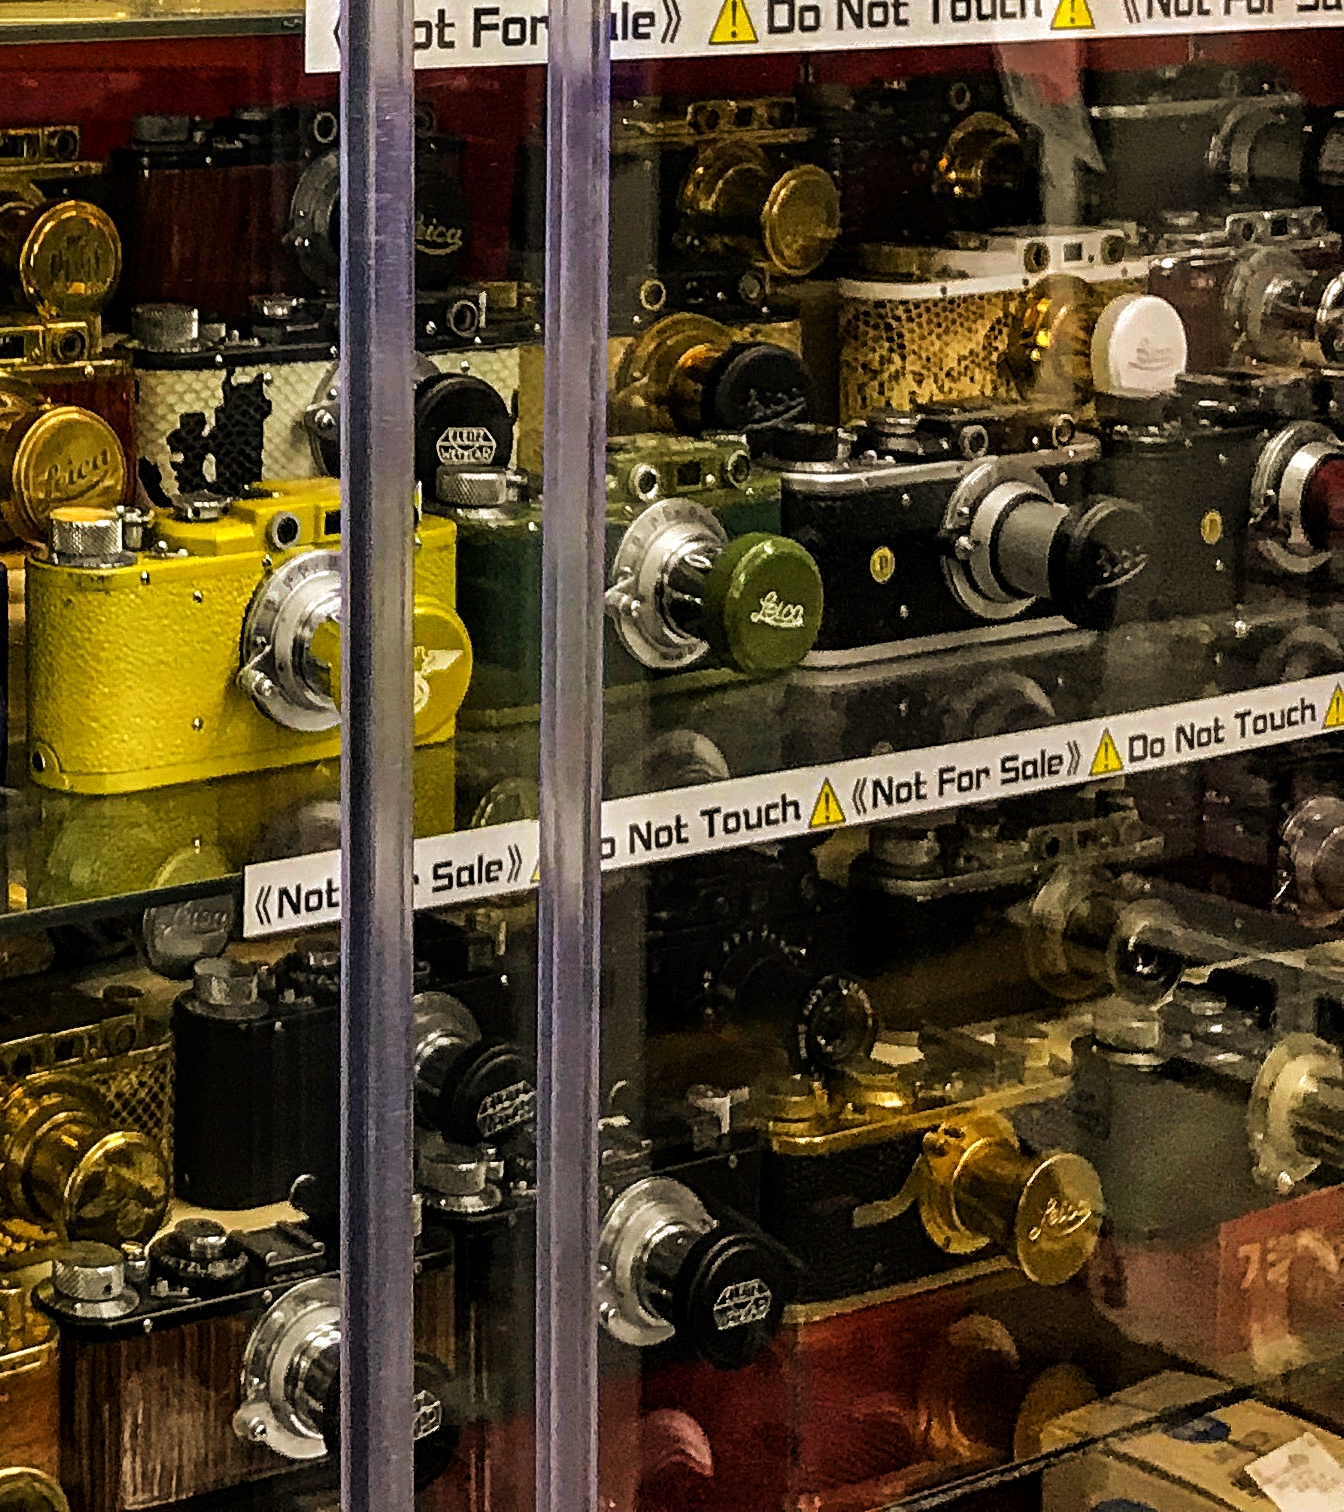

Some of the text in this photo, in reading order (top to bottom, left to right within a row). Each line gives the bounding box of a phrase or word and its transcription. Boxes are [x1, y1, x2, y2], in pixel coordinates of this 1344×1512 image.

[472, 5, 549, 48] For
[627, 818, 690, 854] Not
[700, 797, 801, 837] Touch
[938, 764, 993, 798] For
[1127, 731, 1167, 764] Do
[1175, 715, 1225, 751] Not
[1233, 697, 1317, 737] Touch
